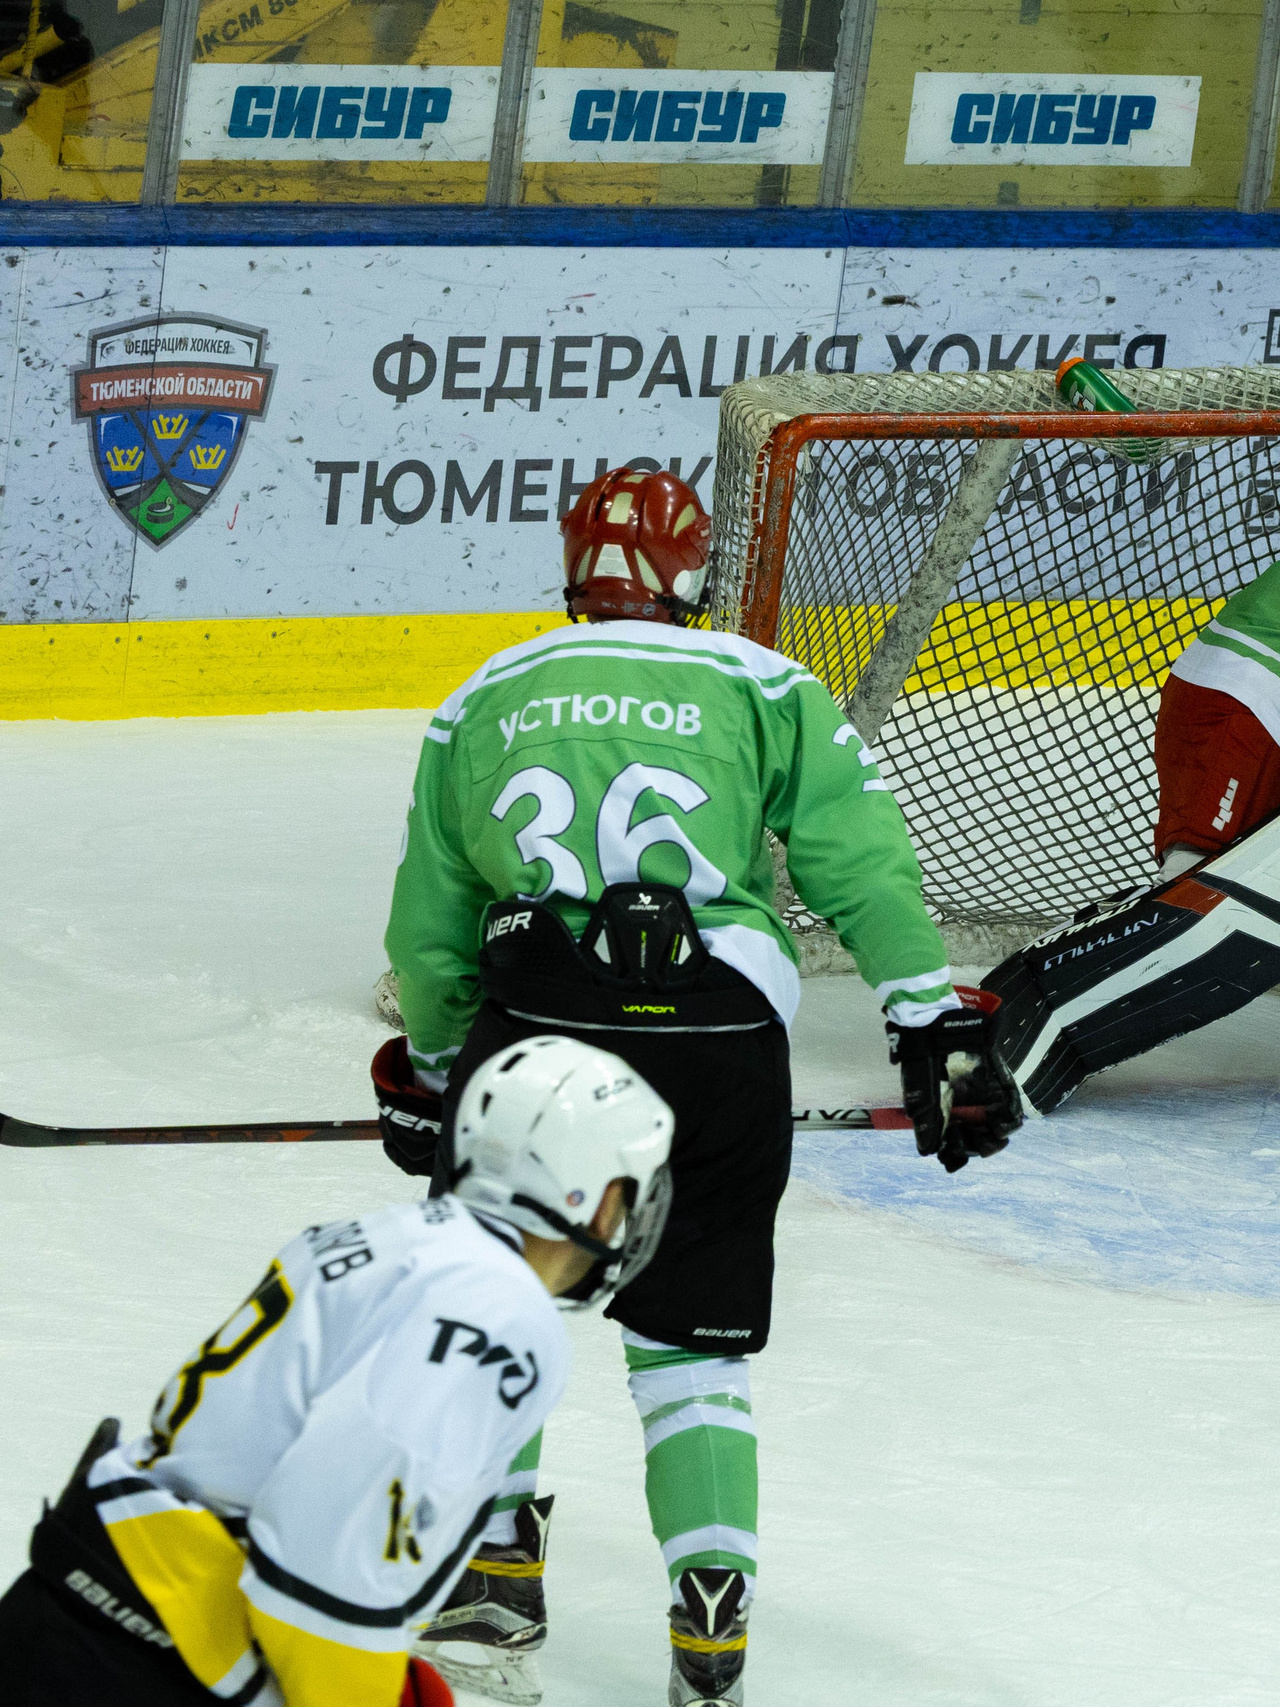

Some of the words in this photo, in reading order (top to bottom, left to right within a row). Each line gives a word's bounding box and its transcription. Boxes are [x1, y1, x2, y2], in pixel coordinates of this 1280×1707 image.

[228, 86, 452, 139] СИБУР
[569, 90, 786, 143] СИБУР
[951, 93, 1156, 145] СИБУР
[125, 337, 189, 356] ФЕДЕРАЦИЯ
[190, 338, 231, 354] ХОККЕЯ
[90, 373, 185, 401] ТЮМЕНСКОЙ
[186, 377, 253, 400] ОБЛАСТИ
[499, 693, 702, 751] УСТЮГОВ
[490, 763, 728, 902] 36
[486, 911, 533, 943] UER
[621, 1004, 677, 1015] VAPOR
[943, 1018, 984, 1029] BAUER
[692, 1327, 752, 1339] BAUER
